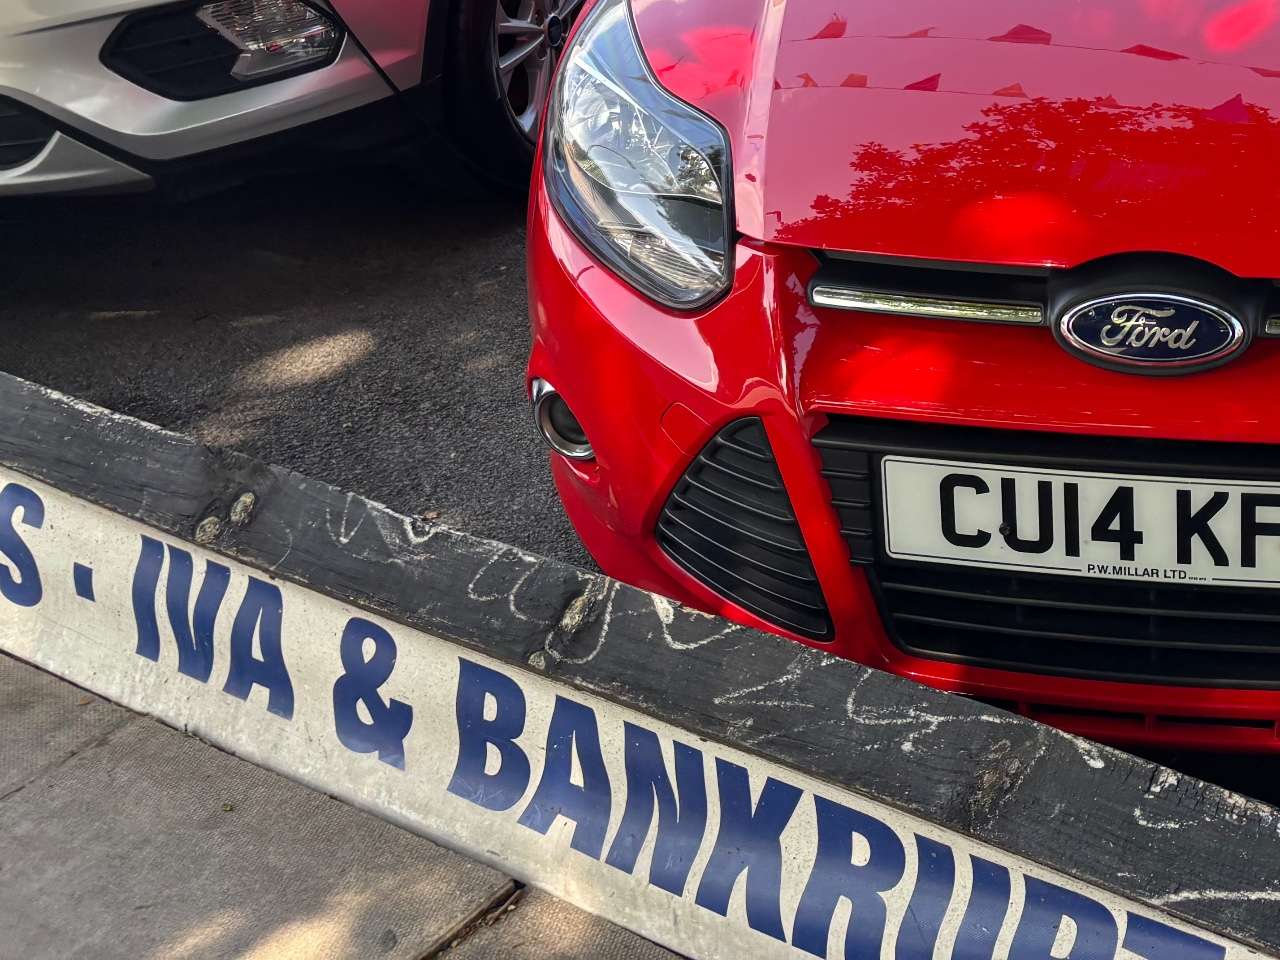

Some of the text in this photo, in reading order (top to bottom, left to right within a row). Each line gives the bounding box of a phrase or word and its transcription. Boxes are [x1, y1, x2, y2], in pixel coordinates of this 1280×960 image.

[1100, 305, 1200, 354] Ford
[939, 474, 1143, 562] CU14
[1163, 569, 1187, 580] LTD
[133, 534, 294, 721] IVA
[332, 616, 413, 771] &
